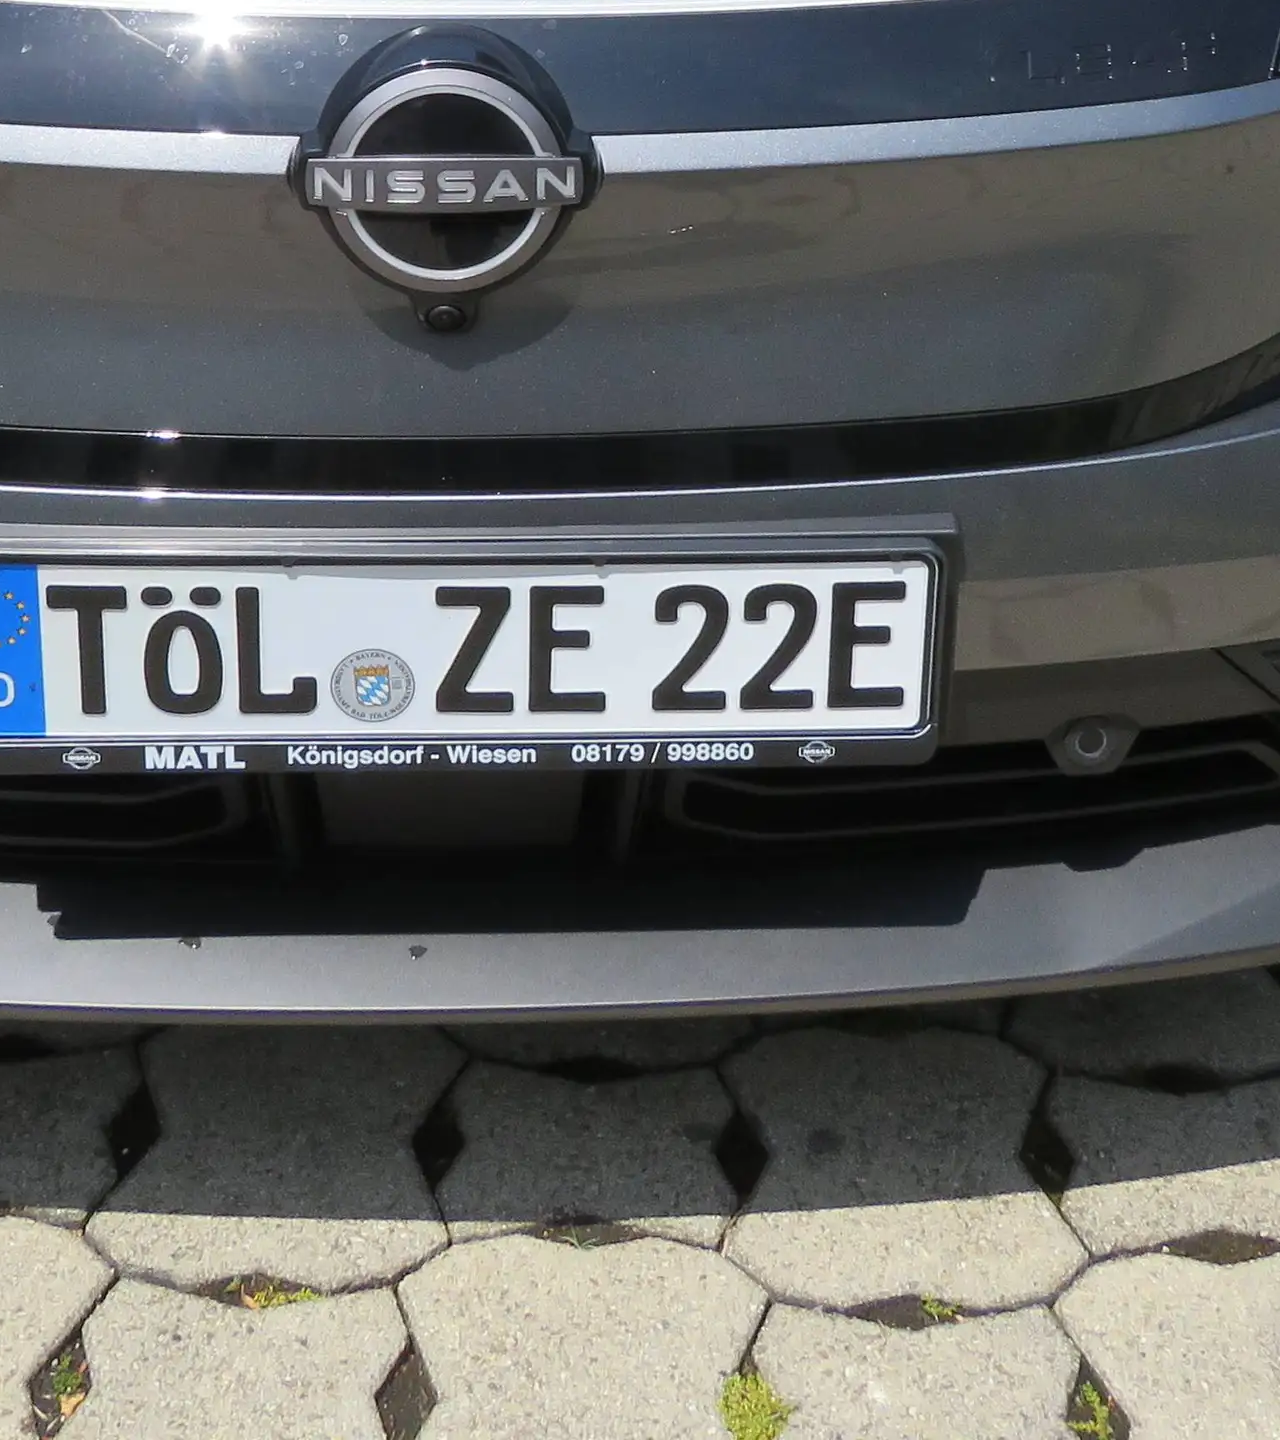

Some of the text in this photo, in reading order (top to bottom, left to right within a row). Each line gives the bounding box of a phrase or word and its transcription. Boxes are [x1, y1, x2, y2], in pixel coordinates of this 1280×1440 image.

[313, 166, 576, 203] NISSAN
[46, 581, 907, 714] TÖL ZE 22E
[144, 746, 246, 770] MATL
[287, 745, 424, 769] Königsdorf
[446, 745, 537, 765] Wiesen
[571, 743, 645, 763] 08179
[650, 742, 661, 764] /
[666, 743, 754, 762] 998860
